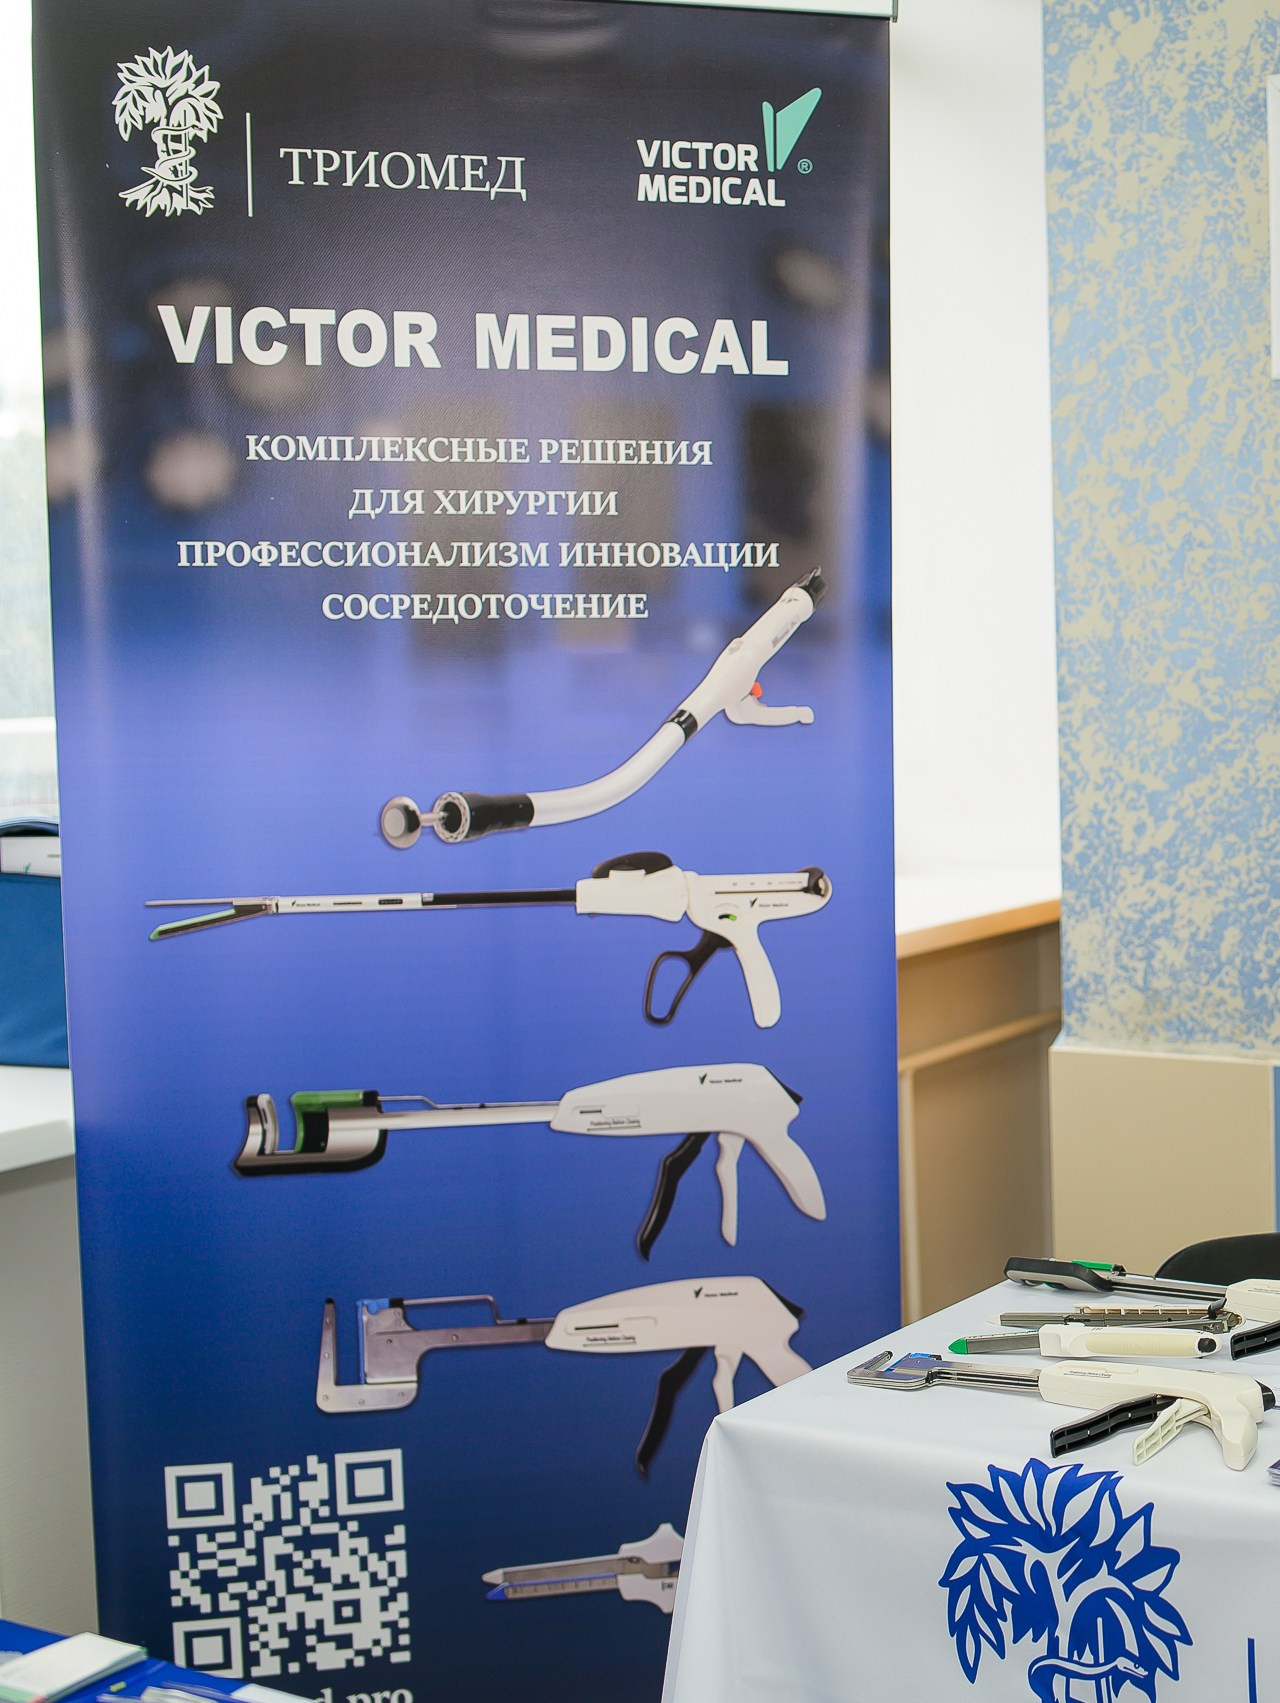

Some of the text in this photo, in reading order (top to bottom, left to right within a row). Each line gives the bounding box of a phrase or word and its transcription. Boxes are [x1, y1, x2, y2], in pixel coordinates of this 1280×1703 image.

[636, 139, 759, 172] VICTOR
[279, 147, 527, 202] ТРИОМЕД
[637, 174, 786, 207] MEDICAL
[157, 304, 789, 376] VICTOR MEDICAL
[245, 431, 713, 466] КОМПЛЕКСНЫЕ РЕШЕНИЯ
[348, 489, 619, 520] ДЛЯ ХИРУРГИИ
[176, 540, 780, 573] ПРОФЕССИОНАЛИЗМ ИННОВАЦИИ
[321, 593, 649, 625] СОСРЕДОТОЧЕНИЕ
